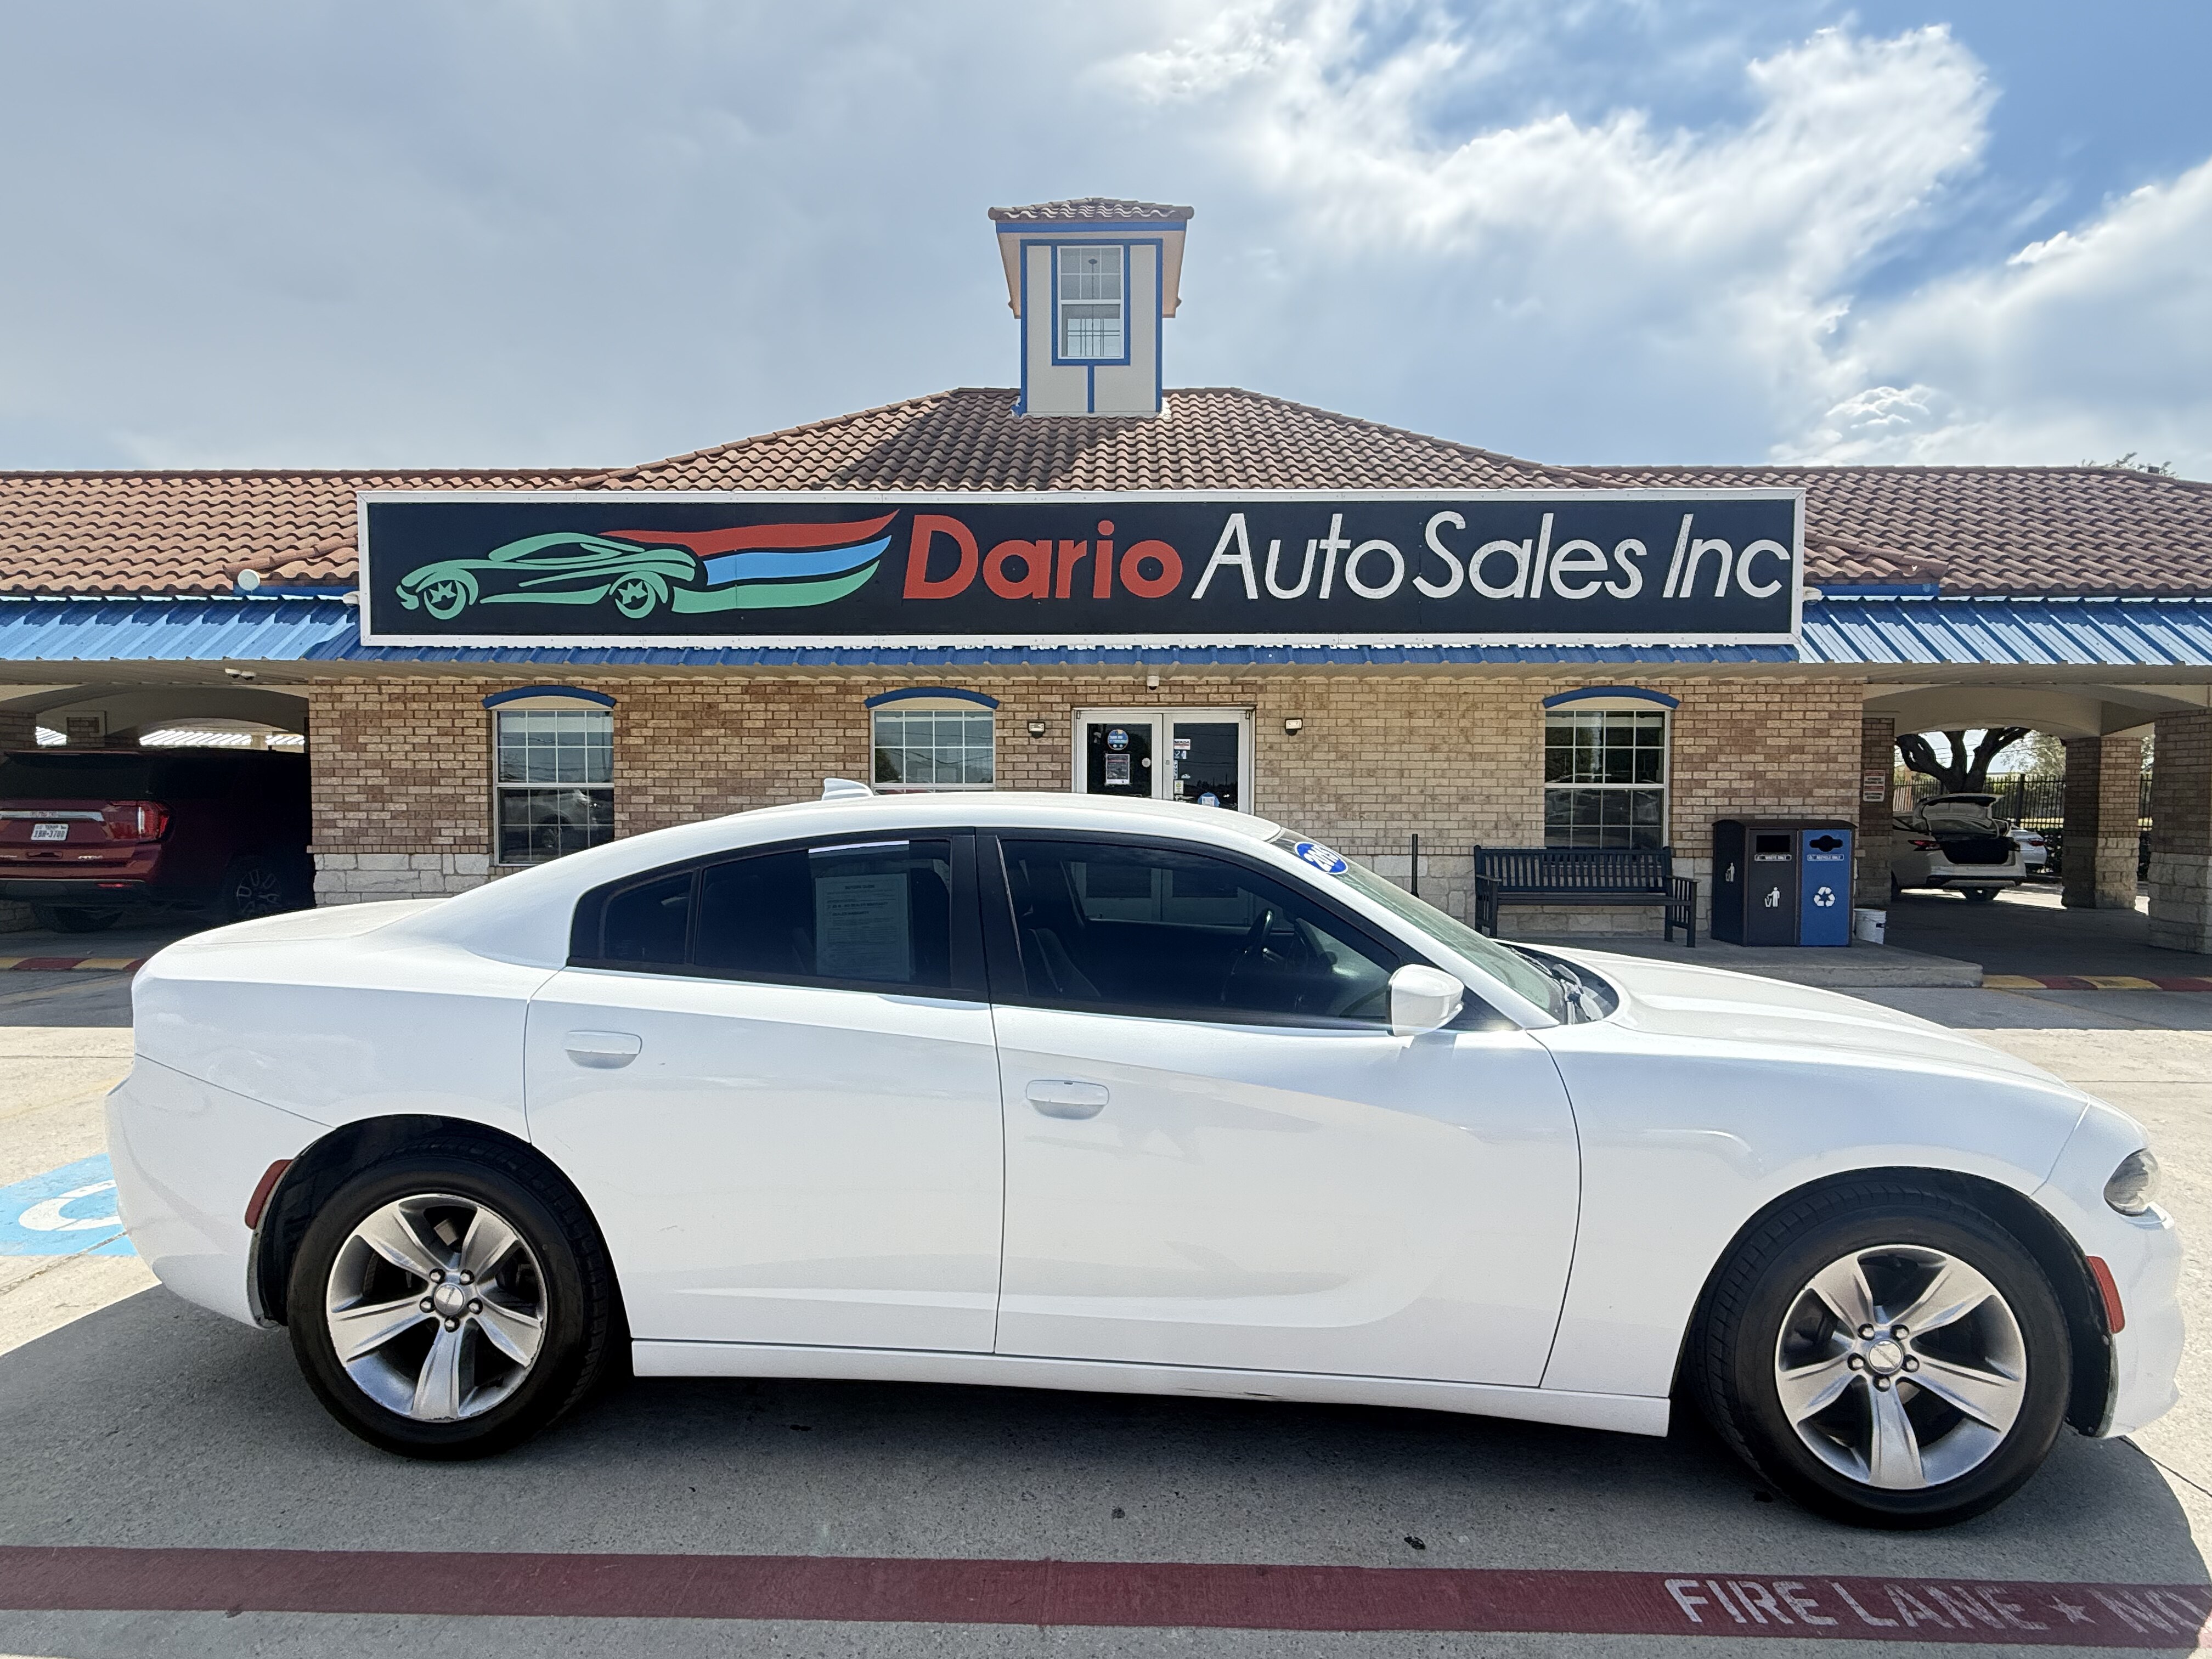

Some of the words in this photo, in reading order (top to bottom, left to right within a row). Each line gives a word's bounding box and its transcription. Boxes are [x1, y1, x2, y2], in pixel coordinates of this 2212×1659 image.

[902, 515, 1183, 599] Dario
[1191, 513, 1405, 599] Auto
[1412, 511, 1647, 599] Sales
[1663, 514, 1791, 599] Inc
[1664, 1578, 1837, 1626] FIRE
[1834, 1581, 2051, 1632] LANE
